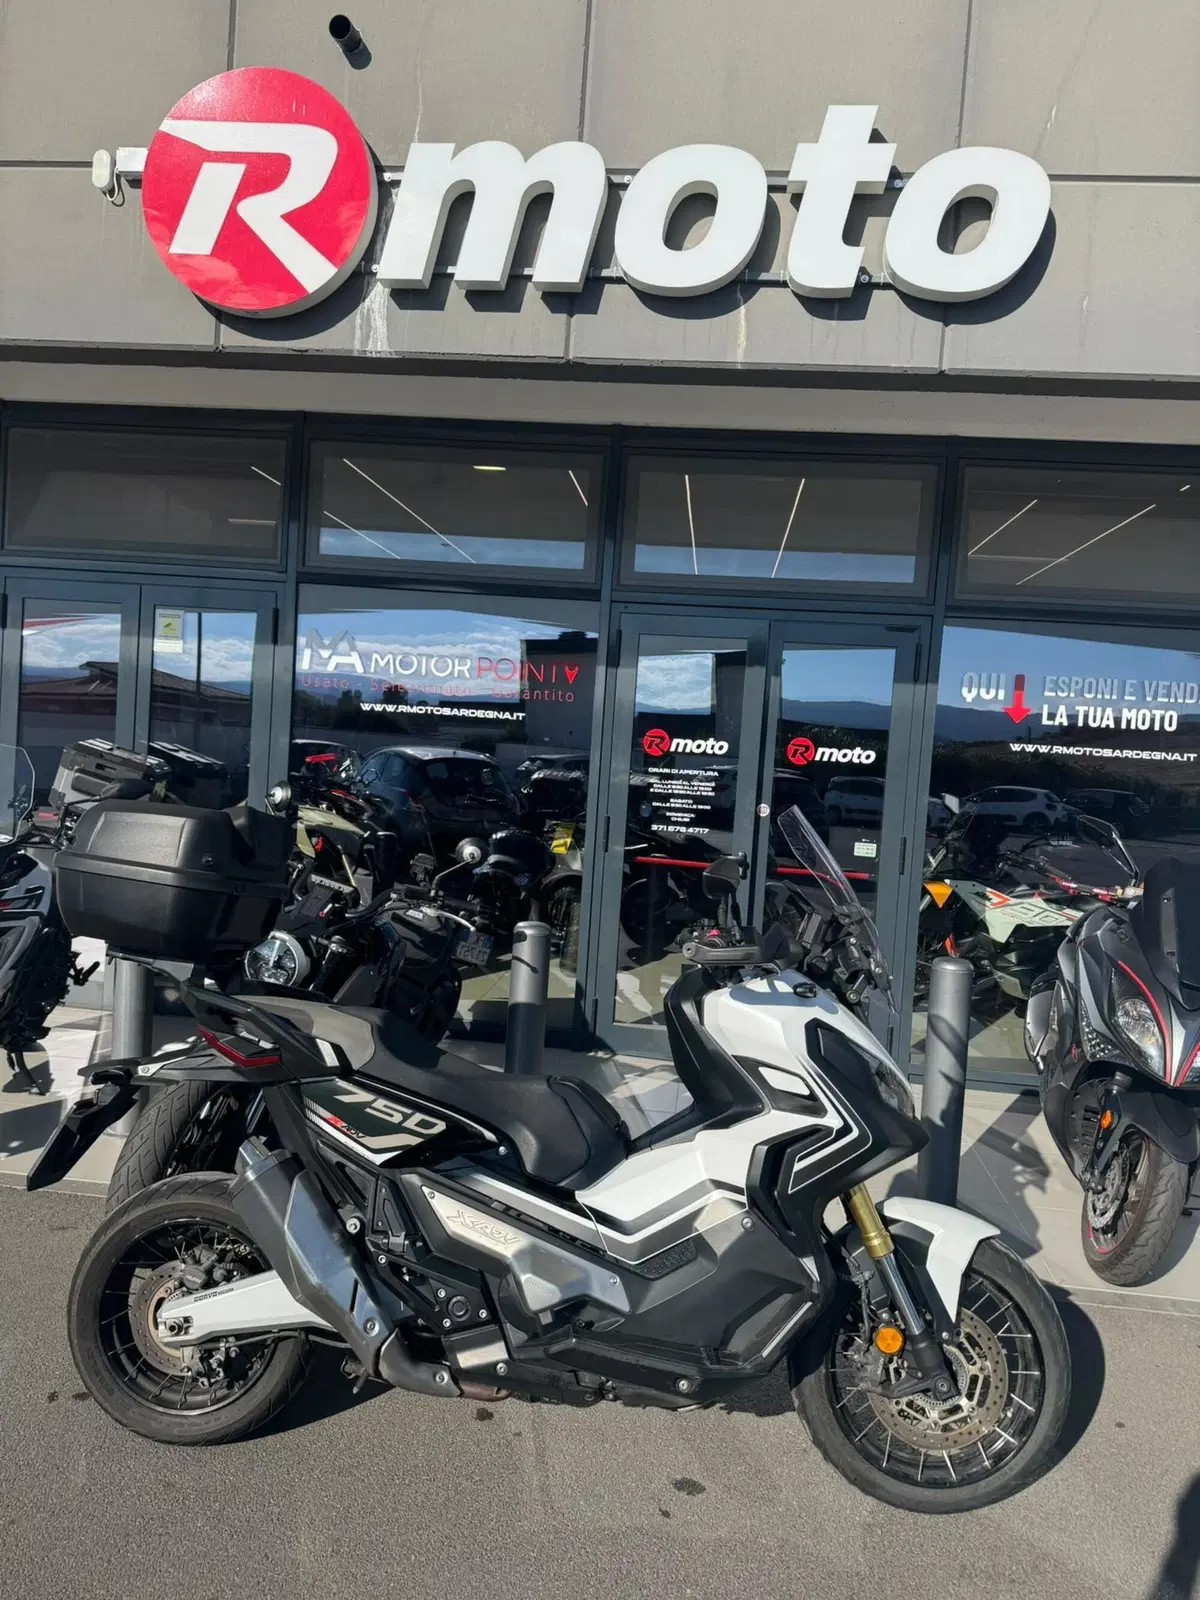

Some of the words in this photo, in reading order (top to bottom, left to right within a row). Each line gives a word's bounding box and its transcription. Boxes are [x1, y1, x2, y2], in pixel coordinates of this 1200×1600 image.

[377, 104, 1052, 303] moto
[301, 673, 350, 689] Usato
[961, 671, 1007, 704] QUI
[1043, 675, 1119, 700] ESPONI
[1125, 679, 1138, 701] E
[1143, 680, 1200, 704] VEND
[360, 702, 526, 721] WWW.RMOTOSARDEGNA.IT
[1041, 704, 1068, 727] LA
[1075, 705, 1115, 729] TUA
[1121, 707, 1178, 732] MOTO
[669, 737, 729, 755] moto
[814, 744, 876, 764] moto
[1009, 742, 1198, 762] WWW.RMOTOSARDEGNA.IT
[332, 1078, 447, 1135] 750
